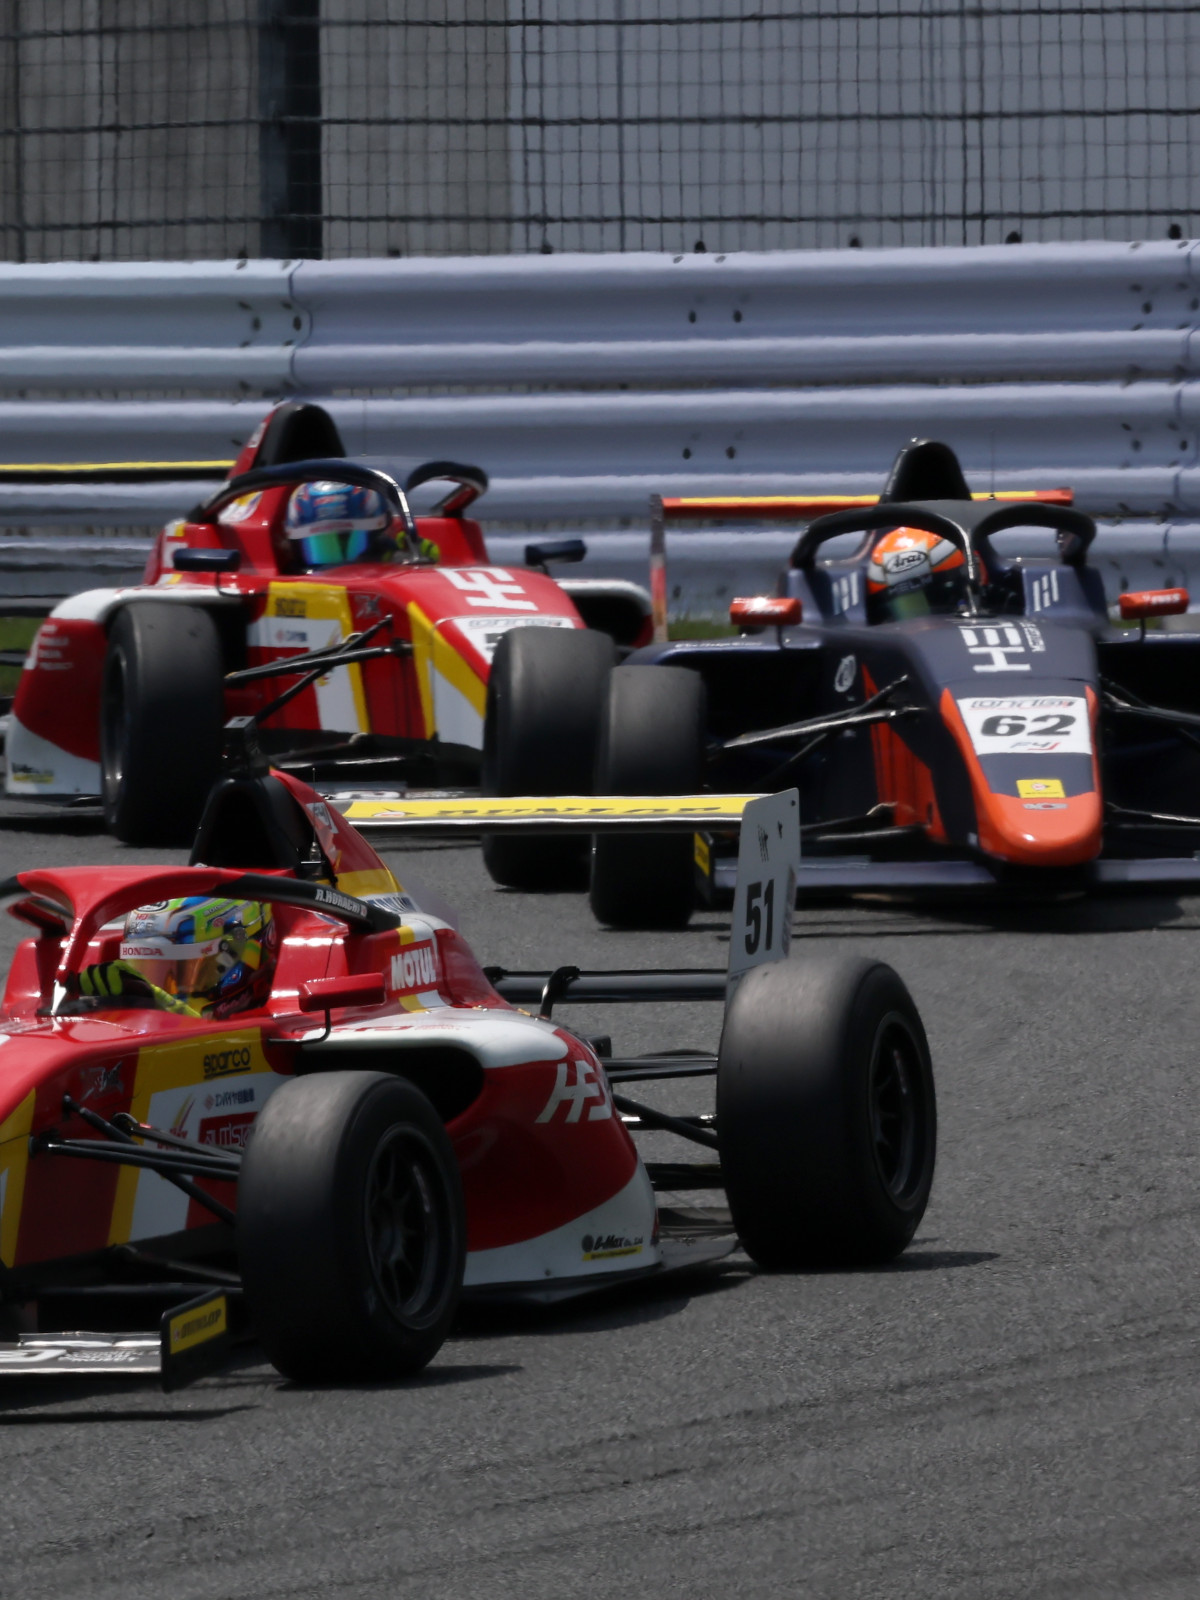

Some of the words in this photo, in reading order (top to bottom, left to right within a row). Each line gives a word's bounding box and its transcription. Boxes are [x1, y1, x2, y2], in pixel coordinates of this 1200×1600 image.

[981, 715, 1076, 737] 62
[744, 878, 775, 956] 51
[121, 947, 164, 957] HONDA
[390, 947, 437, 991] MOTUL
